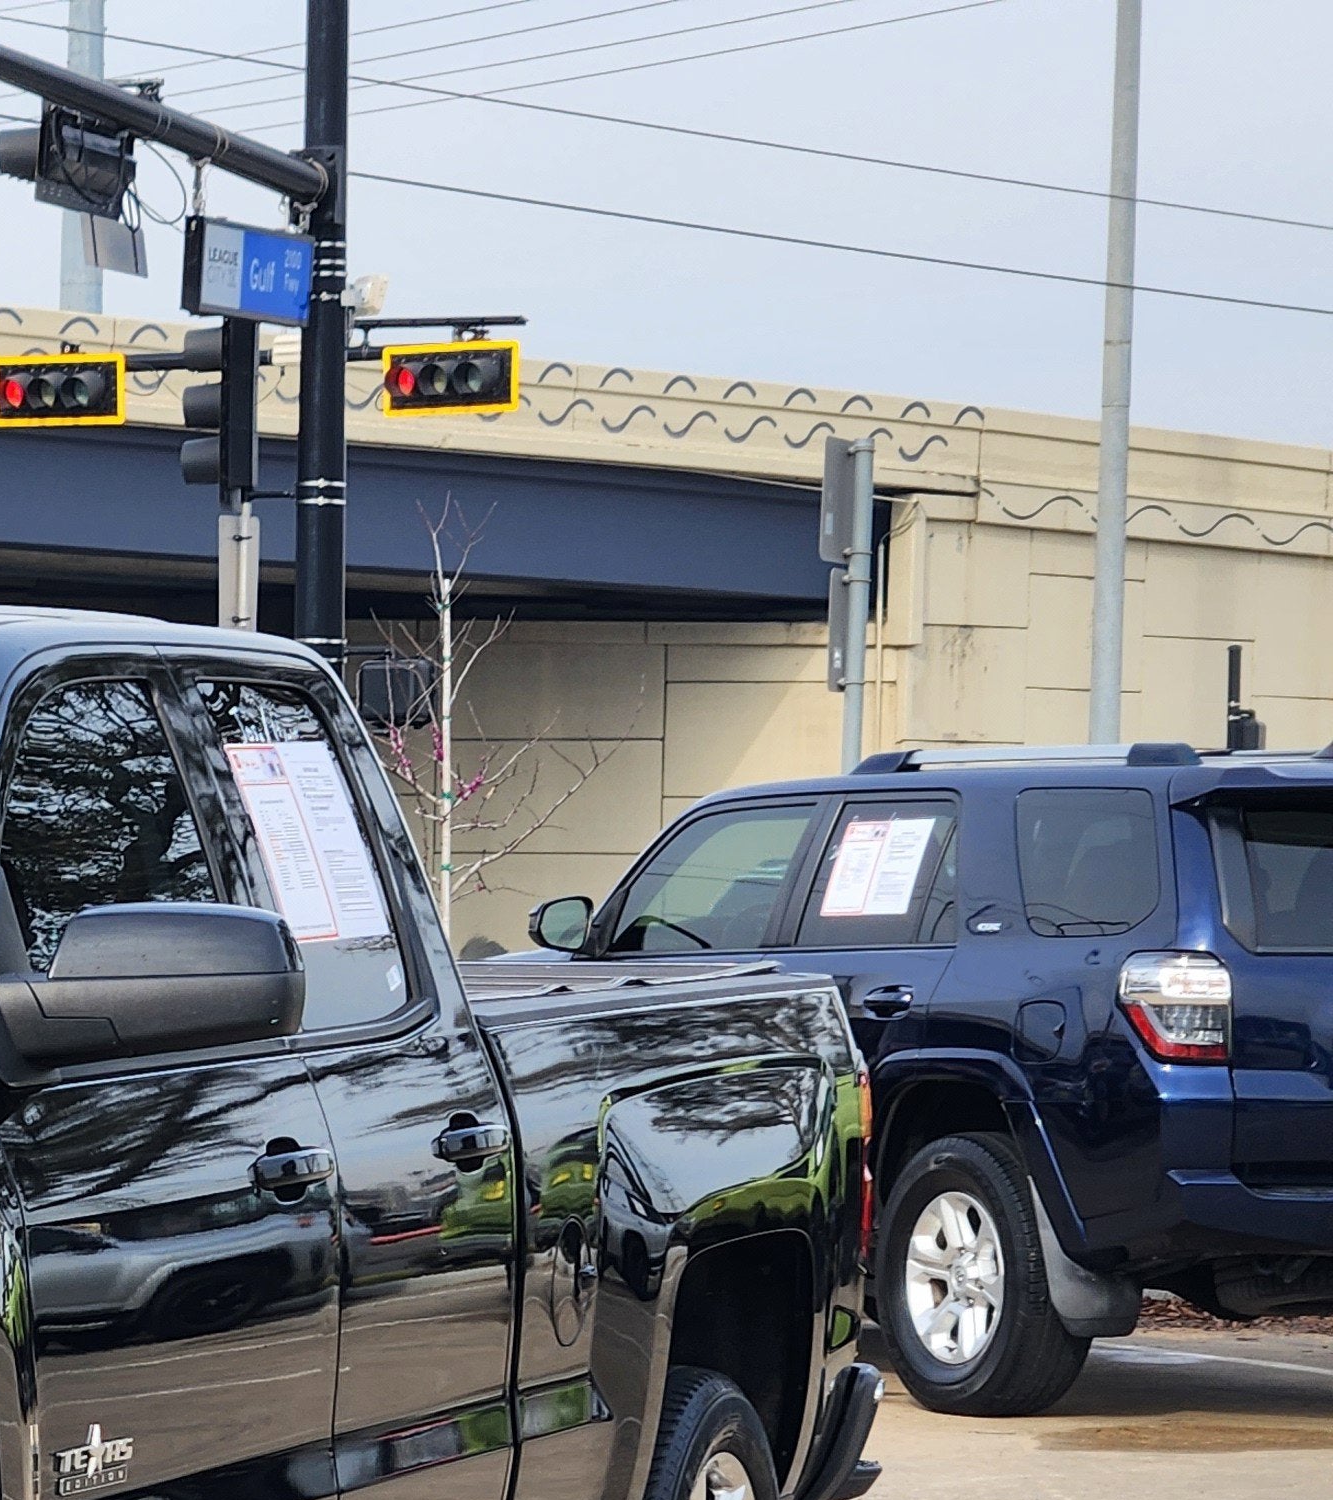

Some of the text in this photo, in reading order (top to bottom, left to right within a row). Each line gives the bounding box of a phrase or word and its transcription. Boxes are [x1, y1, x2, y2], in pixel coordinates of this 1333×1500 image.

[250, 257, 276, 293] Gulf
[56, 1425, 133, 1477] TEXAS
[65, 1470, 125, 1491] EDITION
